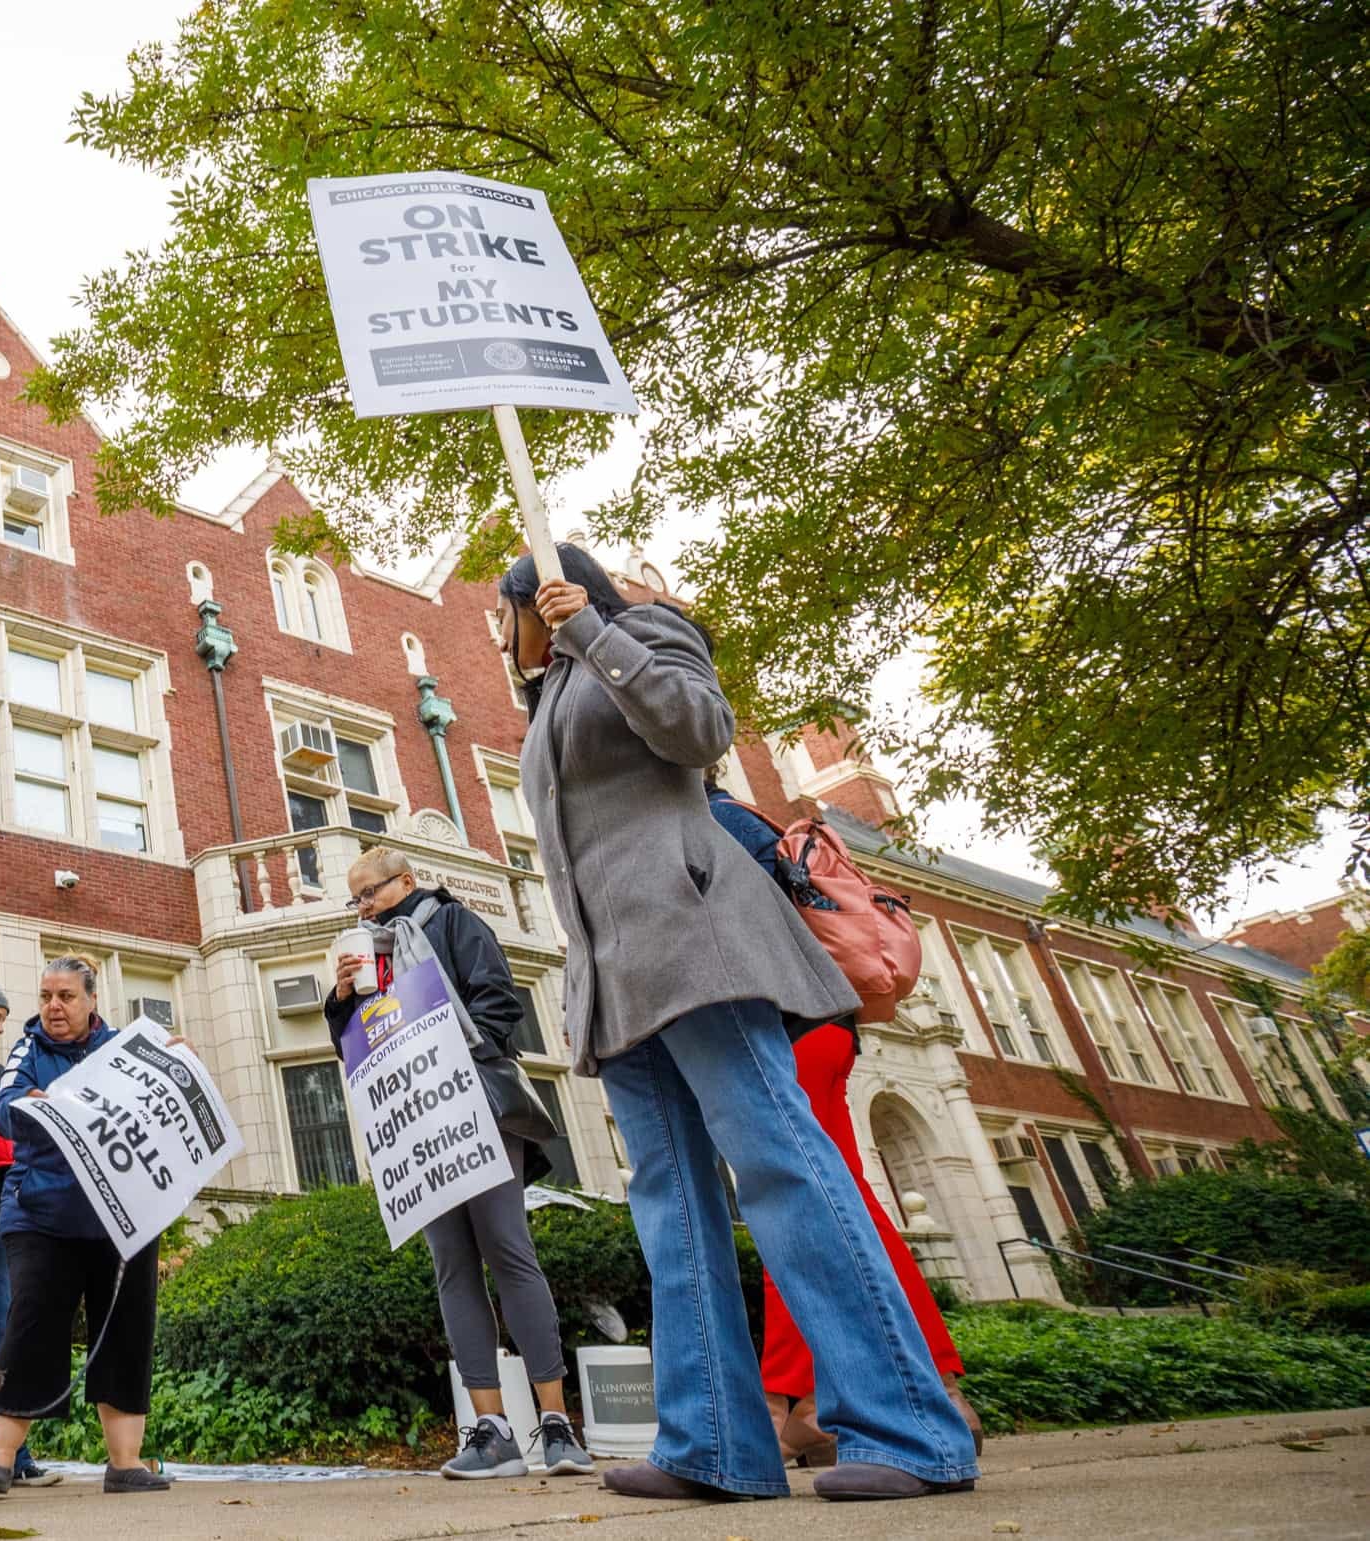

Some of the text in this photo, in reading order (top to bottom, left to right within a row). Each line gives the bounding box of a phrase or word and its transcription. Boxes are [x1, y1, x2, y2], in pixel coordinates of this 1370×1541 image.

[334, 182, 530, 208] CHICAGO PUBLIC SCHOOLS
[403, 204, 485, 230] ON
[358, 231, 546, 267] STRIKE
[449, 263, 476, 273] for
[437, 279, 498, 302] MY
[367, 303, 579, 334] STUDENTS
[531, 355, 587, 368] TEACHERS
[445, 876, 501, 898] SULLIVAN
[367, 1007, 402, 1045] SEIU
[349, 1008, 450, 1090] #FairContractNow
[367, 1045, 440, 1111] Mayor
[33, 1101, 76, 1142] SCHOOLS
[109, 1055, 204, 1166] STUDENTS
[136, 1093, 173, 1129] MY
[137, 1109, 153, 1125] for
[365, 1068, 474, 1157] Lightfoot:
[79, 1087, 174, 1191] STRIKE
[86, 1118, 134, 1174] ON
[382, 1157, 410, 1191] Our
[385, 1141, 497, 1222] Your Watch
[97, 1180, 133, 1234] CHICAGO
